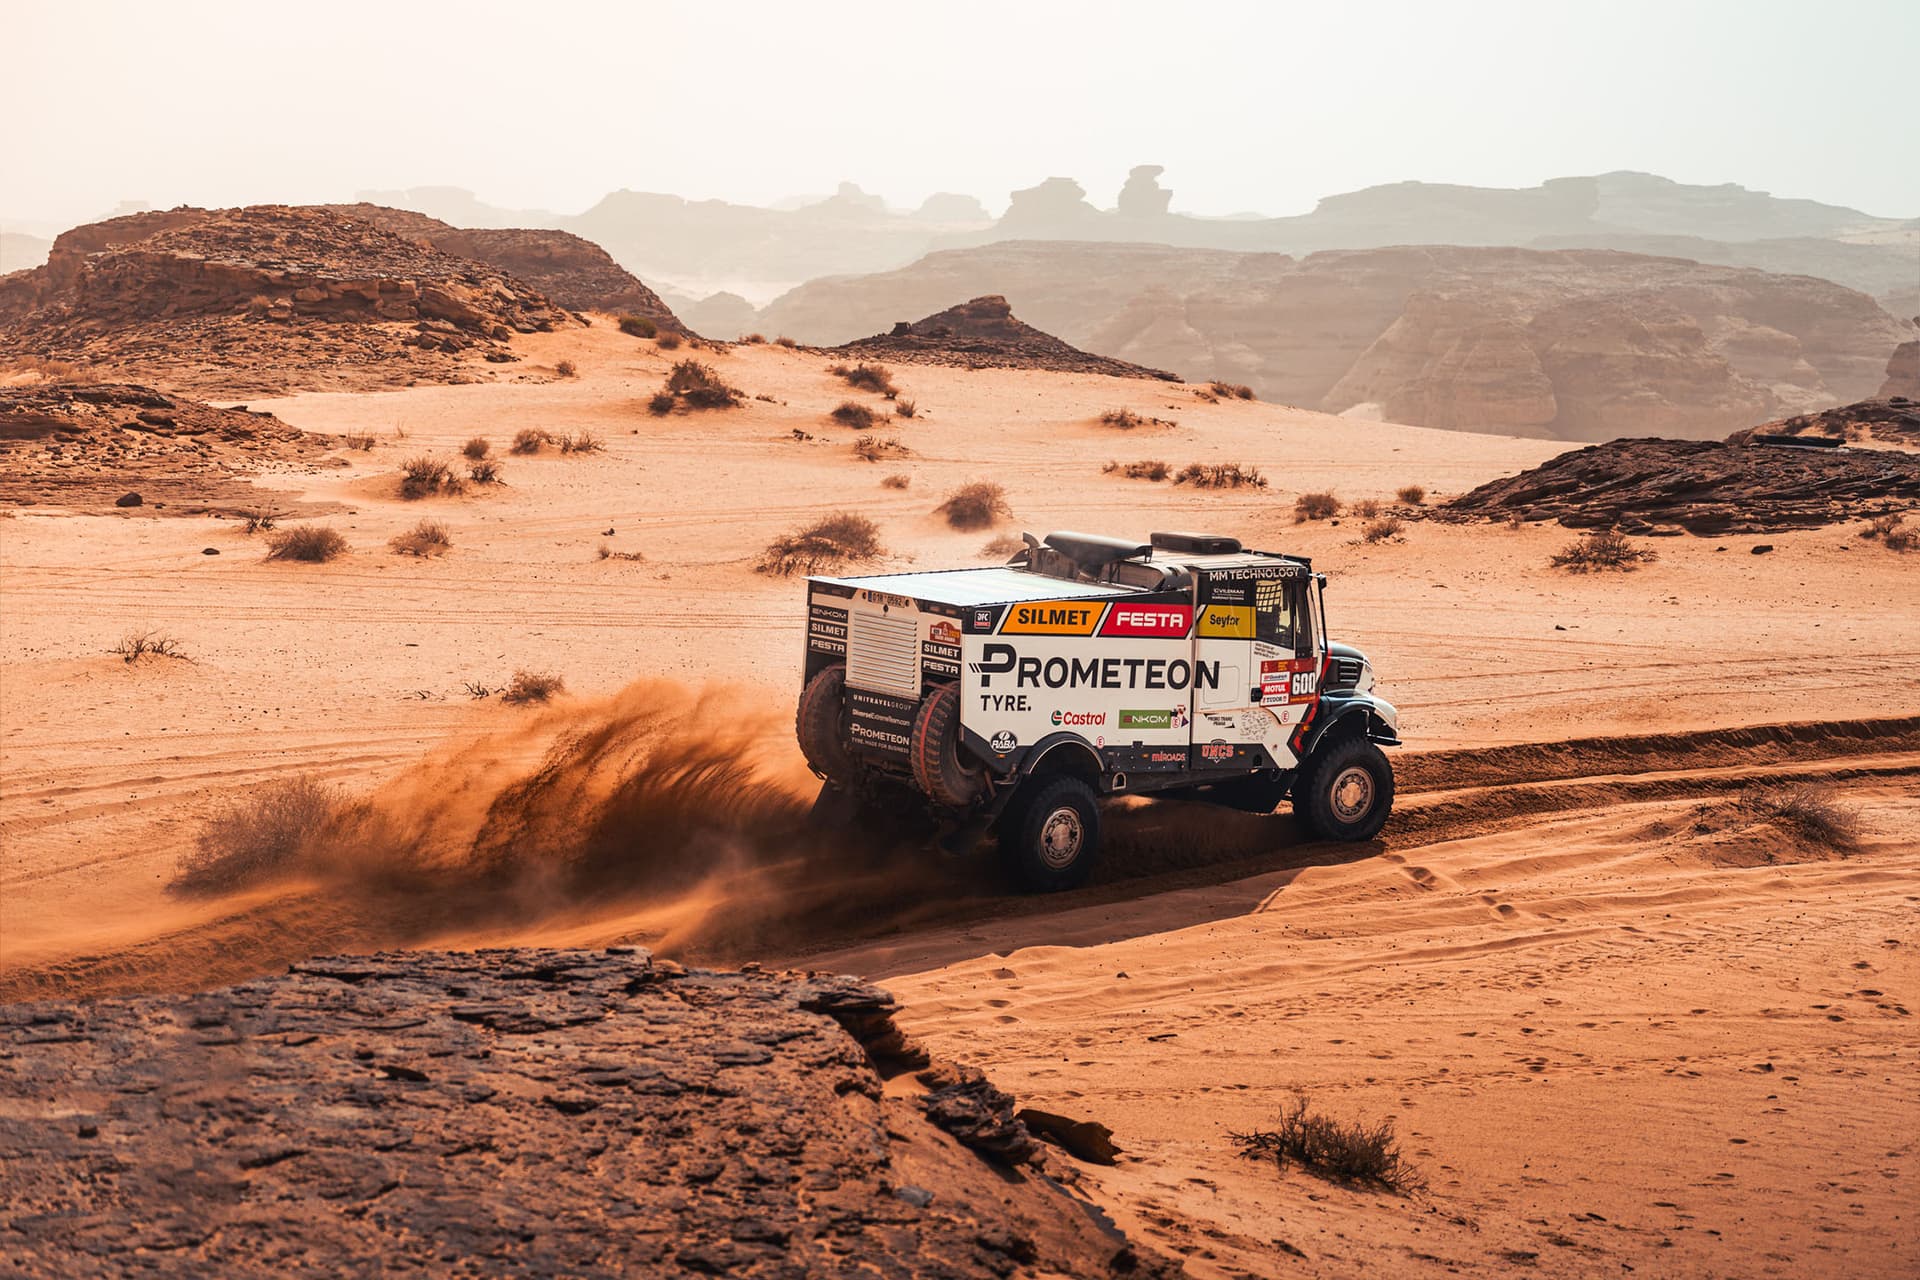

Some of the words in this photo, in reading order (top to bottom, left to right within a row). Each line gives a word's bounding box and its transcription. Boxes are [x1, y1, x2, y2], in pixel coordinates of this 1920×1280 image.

[1209, 571, 1228, 581] MM
[1230, 567, 1299, 580] TECHNOLOGY
[812, 609, 847, 620] ENKOM
[1017, 608, 1091, 626] SILMET
[1116, 611, 1184, 628] FESTA
[1209, 614, 1240, 628] Seyfor
[811, 623, 846, 636] SILMET
[810, 639, 845, 653] FESTA
[923, 643, 959, 658] SILMET
[922, 660, 959, 674] FESTA
[975, 643, 1220, 690] PROMETEON
[1264, 684, 1286, 693] MOTUL
[1292, 672, 1316, 695] 600
[980, 694, 1032, 711] TYRE.
[1063, 711, 1106, 726] Castrol
[1123, 715, 1168, 724] ENKOM
[850, 723, 910, 745] PROMETEON
